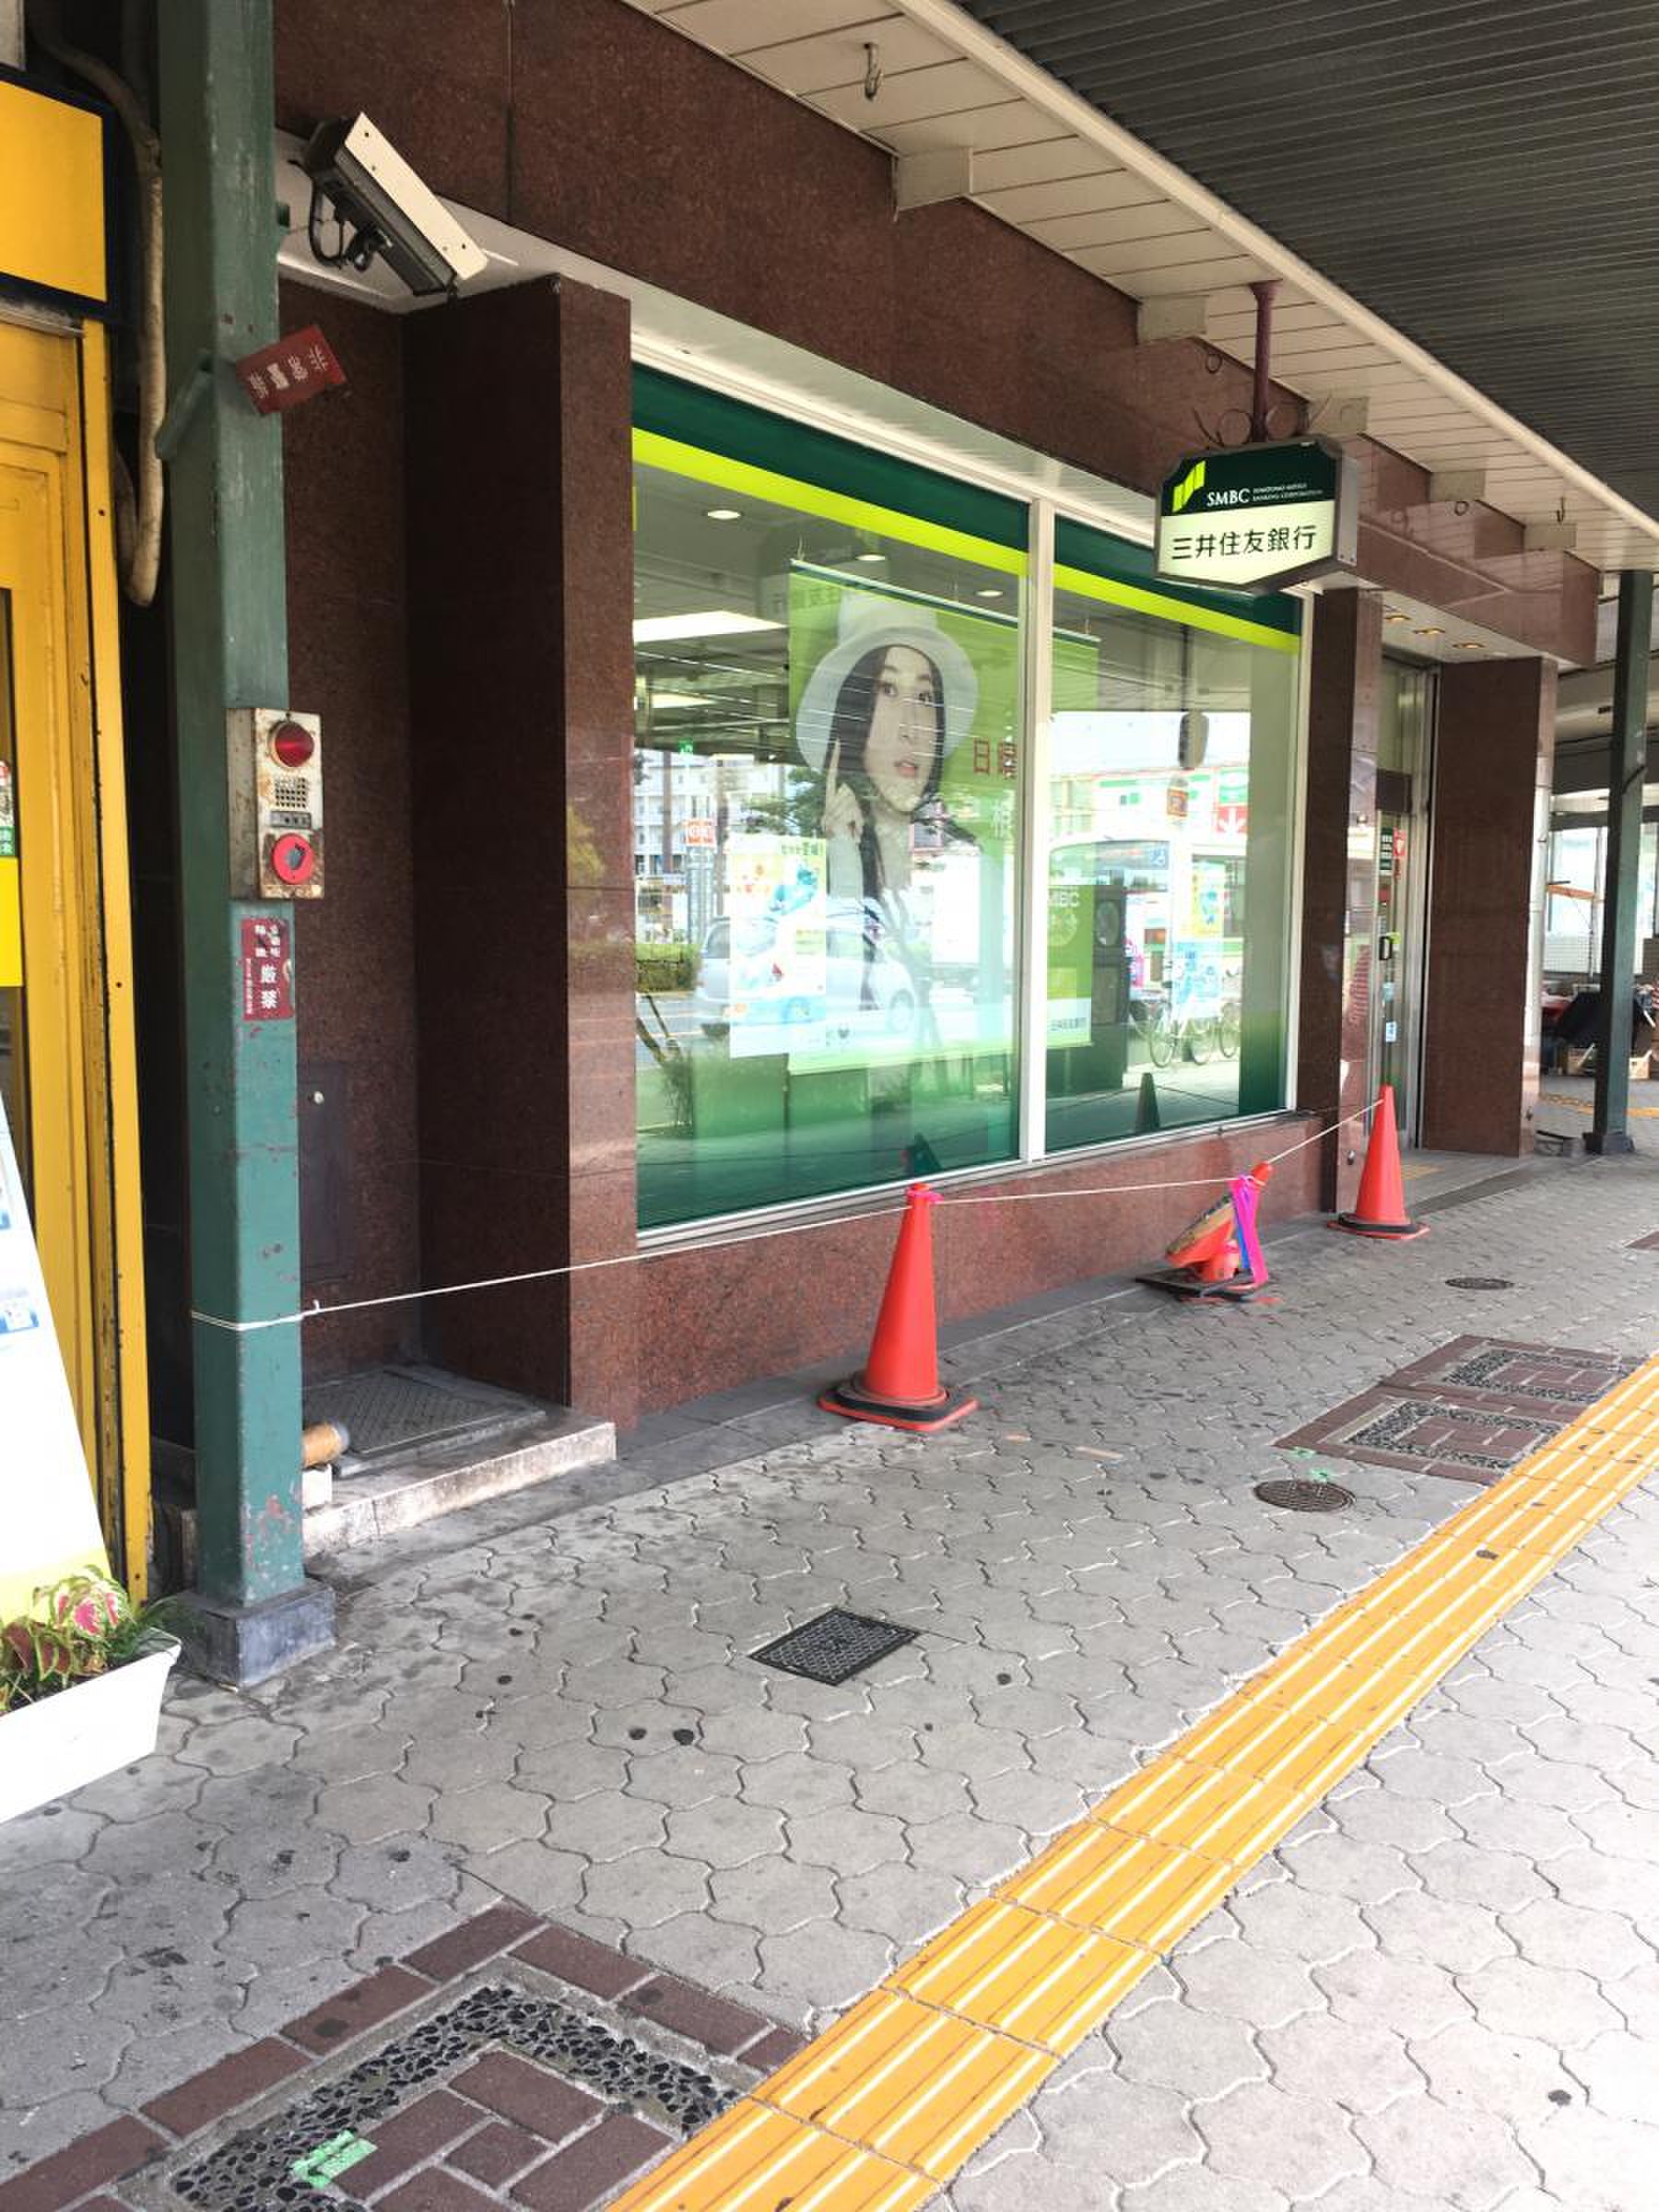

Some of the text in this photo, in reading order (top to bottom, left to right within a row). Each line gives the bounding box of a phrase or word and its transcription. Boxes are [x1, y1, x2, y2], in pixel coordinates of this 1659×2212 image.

[1206, 488, 1251, 507] SMBC
[1171, 524, 1317, 560] 三井住友銀行
